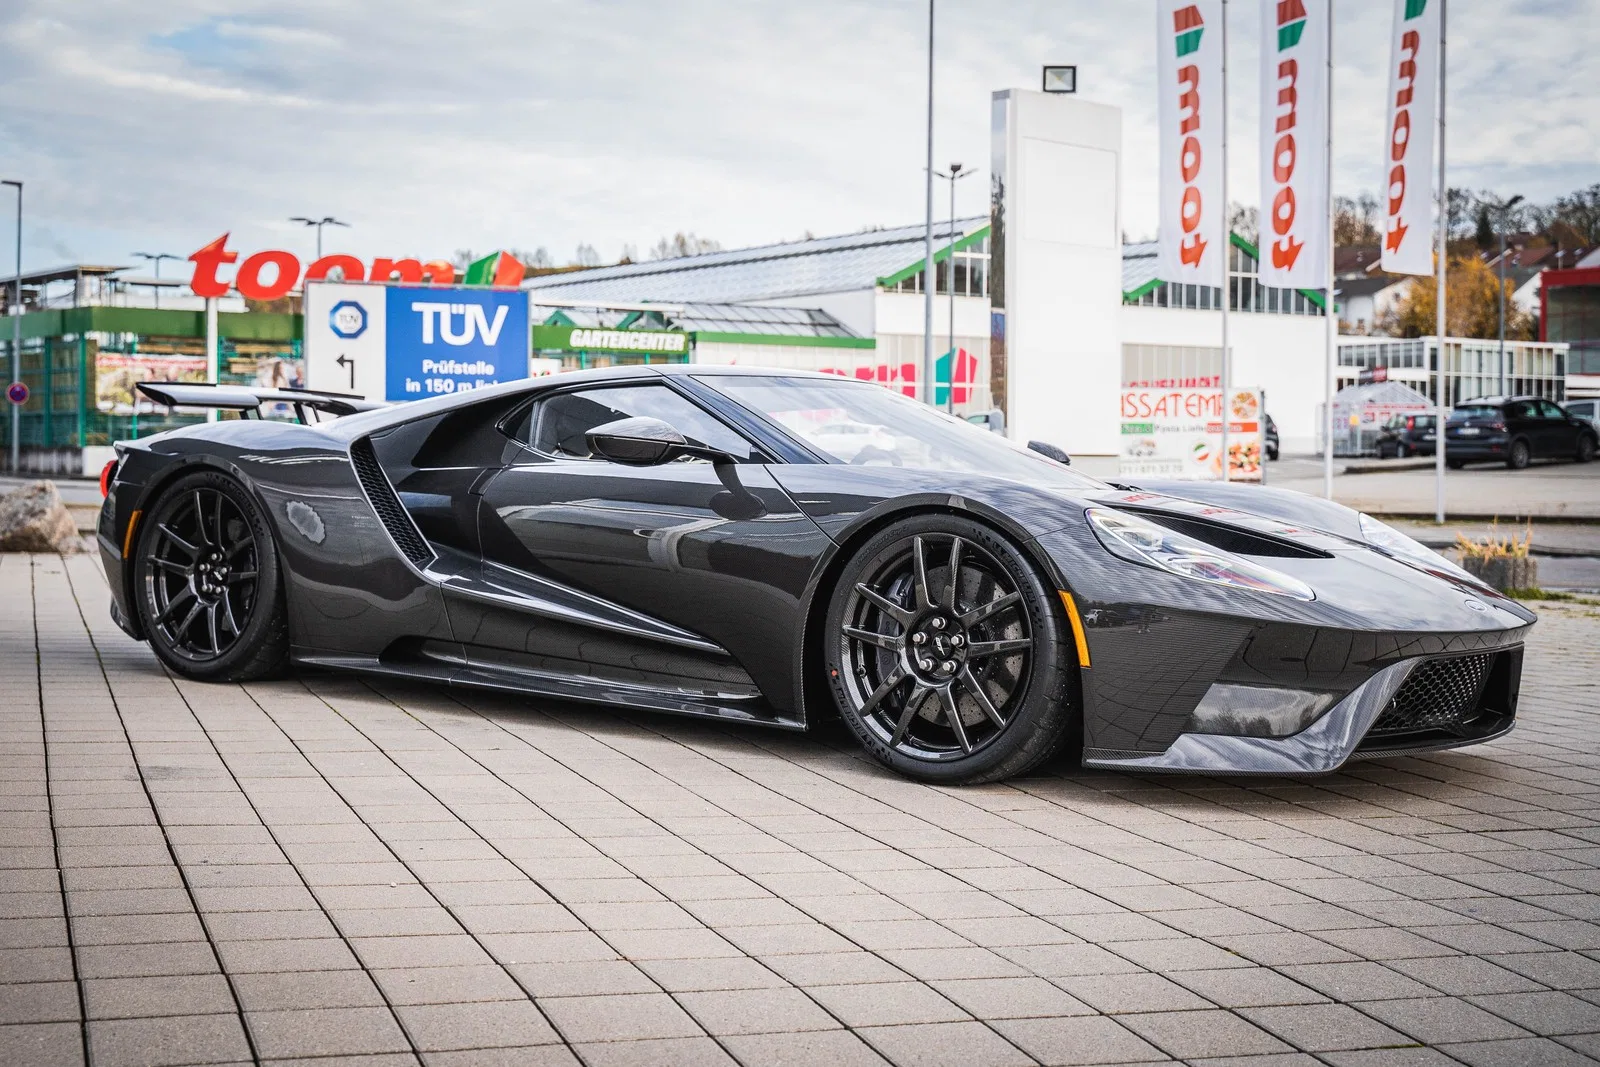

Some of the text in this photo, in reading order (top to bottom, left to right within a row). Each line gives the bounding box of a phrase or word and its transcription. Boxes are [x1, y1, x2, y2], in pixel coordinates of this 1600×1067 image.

[411, 302, 509, 347] TÜV
[569, 329, 686, 351] GARTENCENTER
[422, 359, 495, 375] Prüfstelle
[405, 377, 421, 393] in
[424, 378, 455, 393] 150
